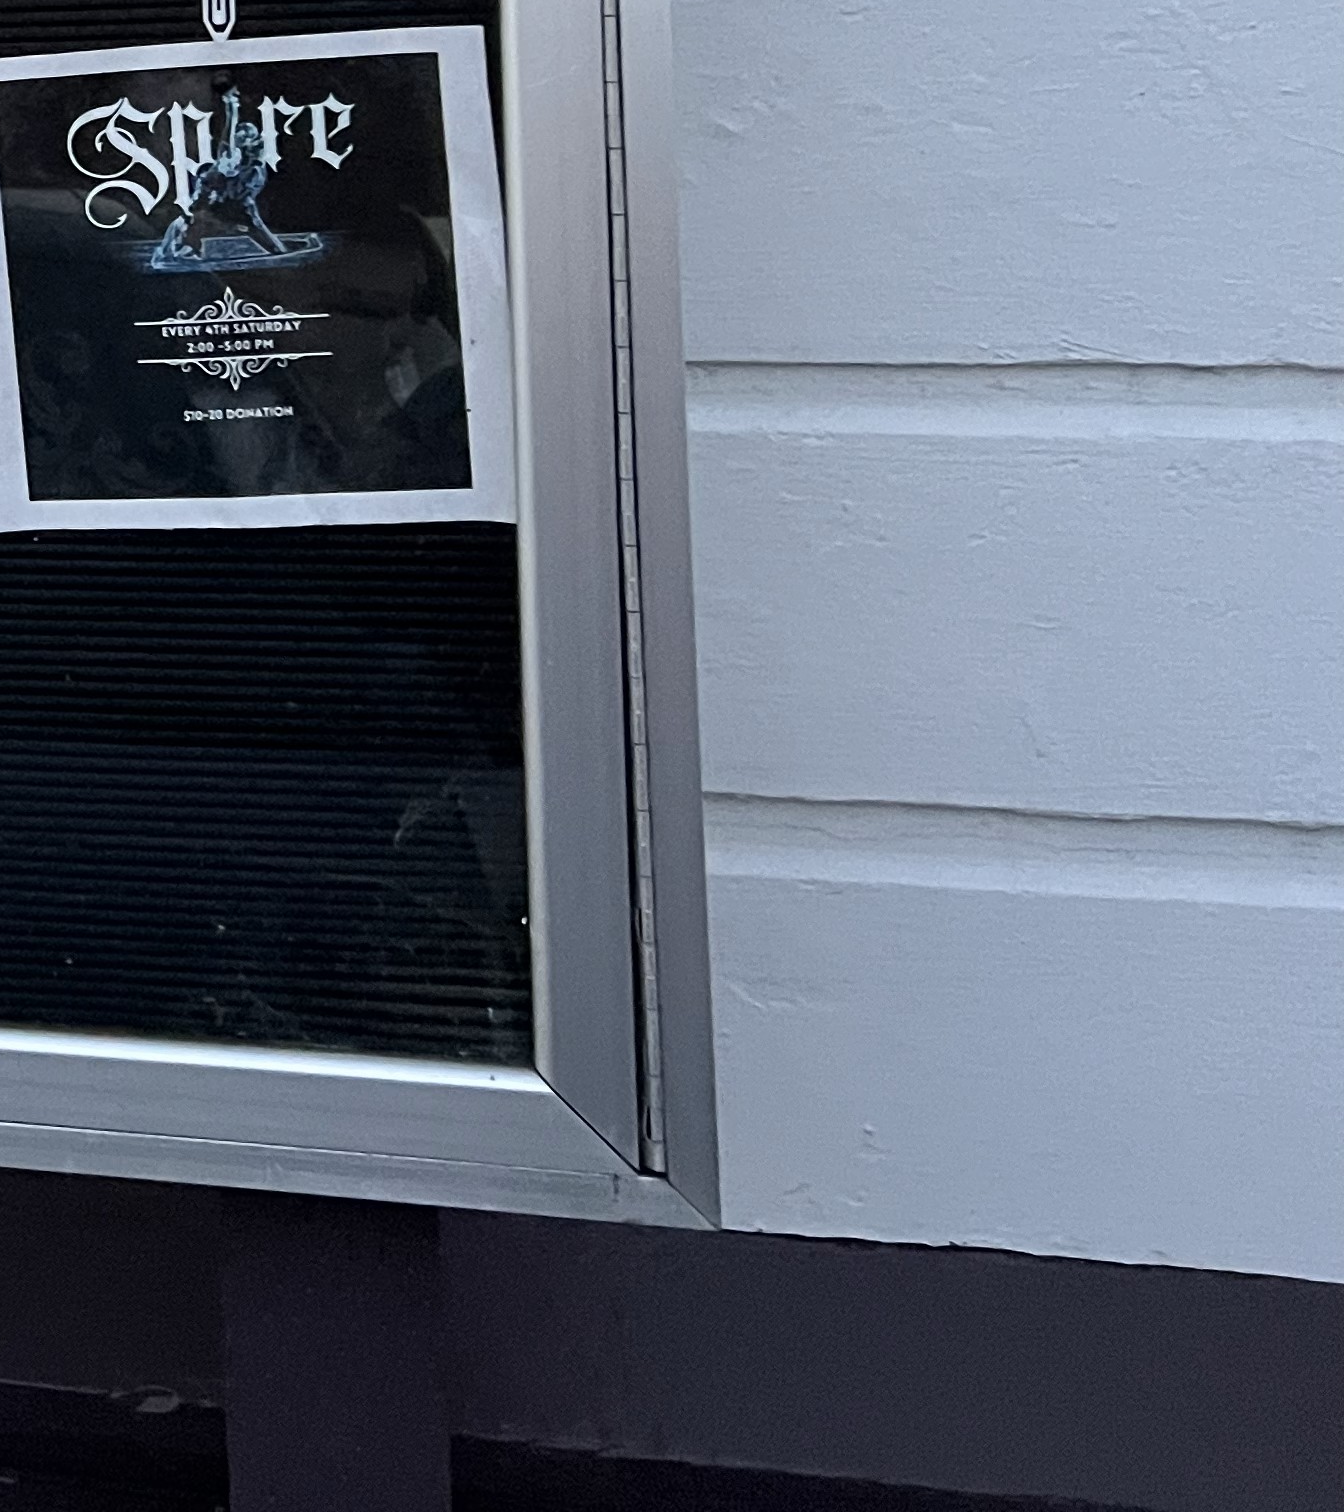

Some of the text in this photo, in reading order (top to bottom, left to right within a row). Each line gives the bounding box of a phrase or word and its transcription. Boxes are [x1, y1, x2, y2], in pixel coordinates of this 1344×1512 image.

[162, 321, 301, 337] EVERY 4TH SATURDAY
[255, 339, 274, 350] PM
[226, 406, 294, 419] DONATION
